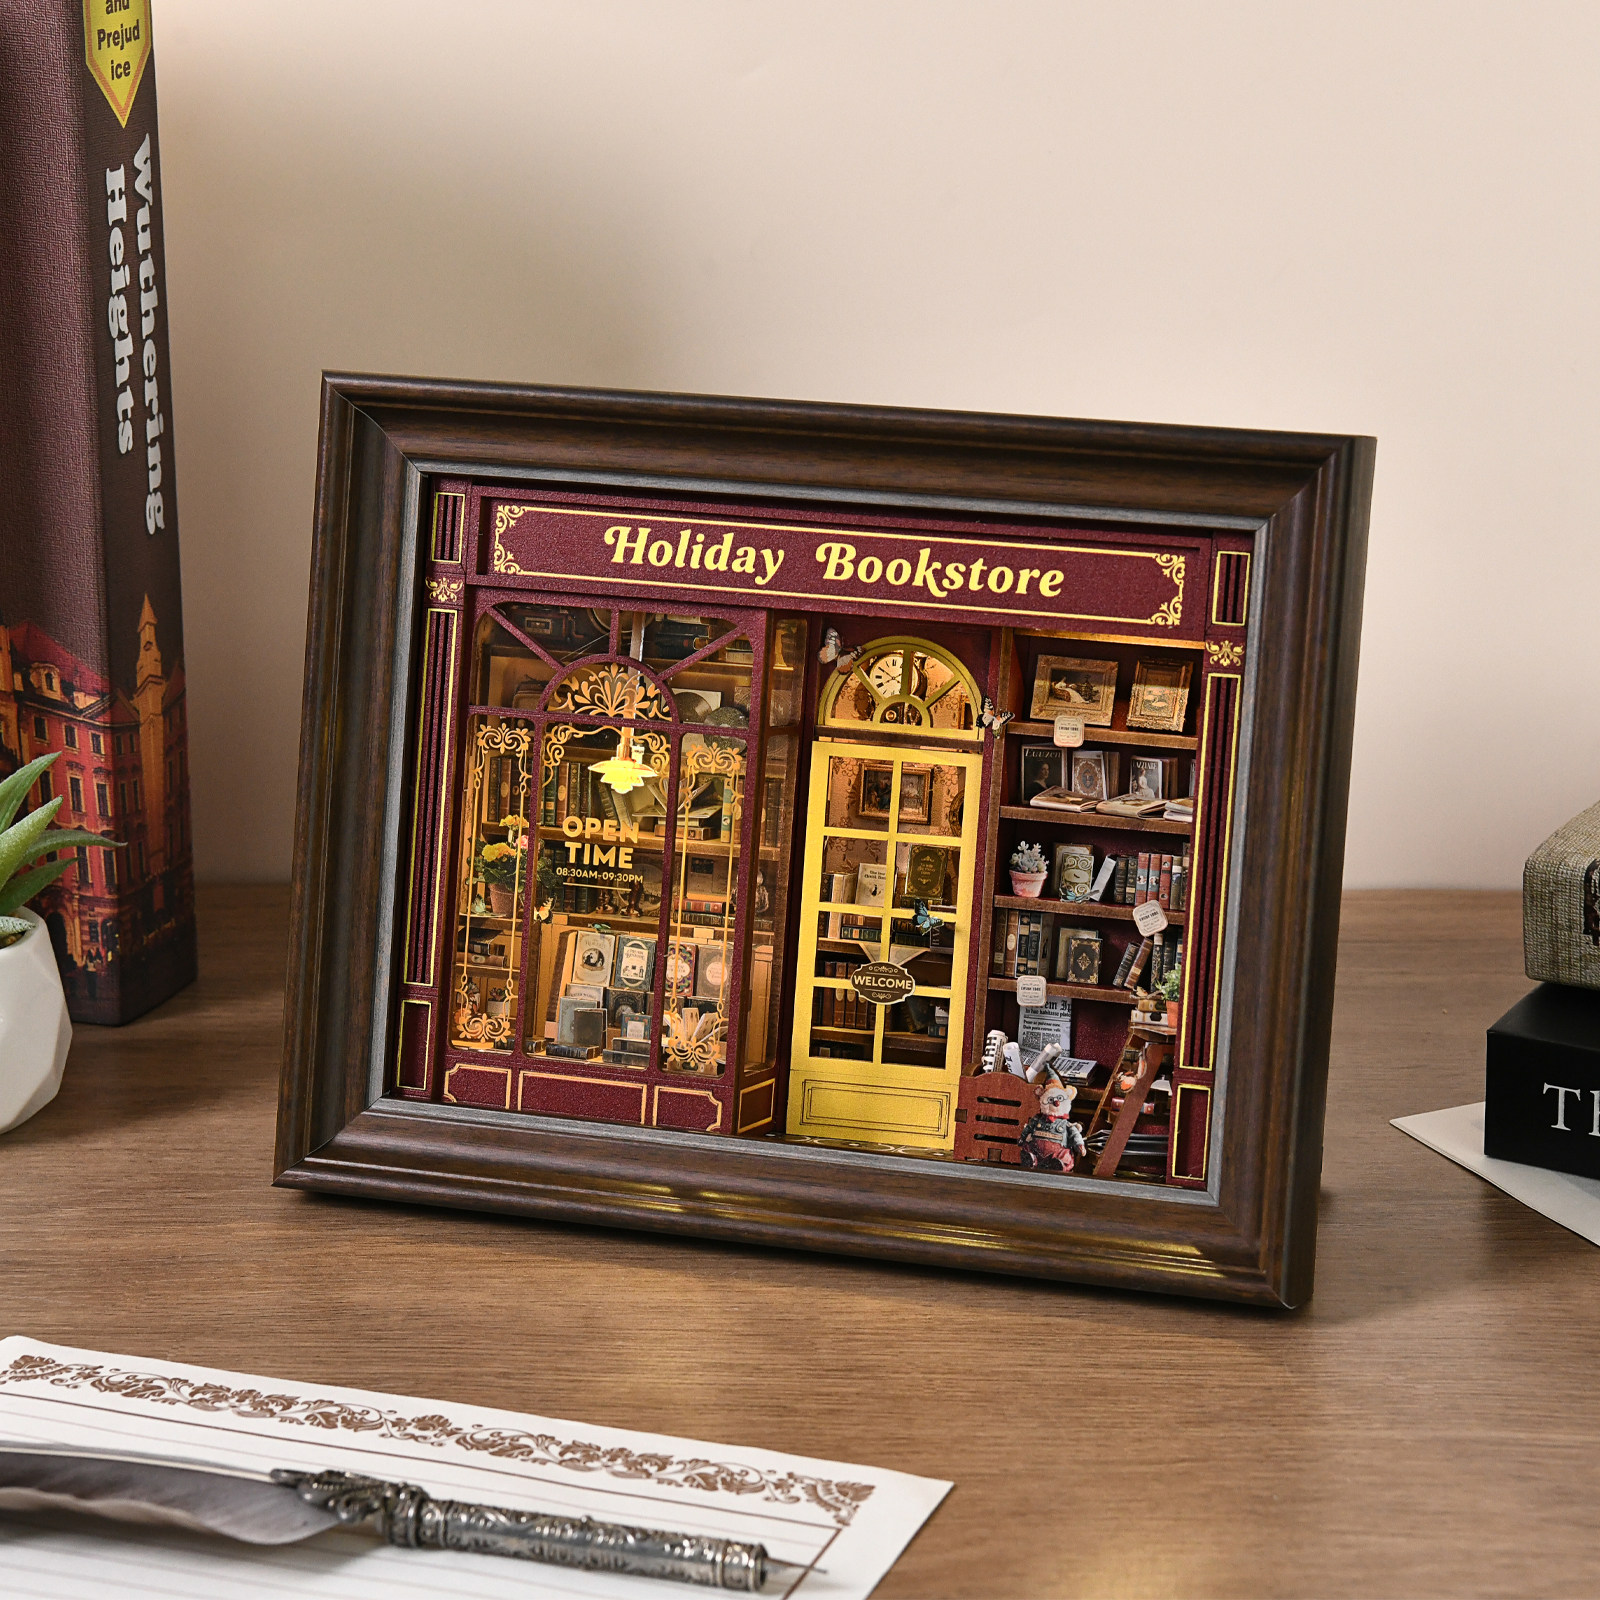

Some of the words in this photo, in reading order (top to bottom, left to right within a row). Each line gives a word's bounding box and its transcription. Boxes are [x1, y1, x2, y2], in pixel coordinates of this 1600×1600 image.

[97, 18, 140, 50] Prejud
[110, 59, 131, 80] ice
[106, 164, 133, 455] Heights
[132, 132, 165, 536] Wuthering
[604, 525, 785, 585] Holiday
[815, 542, 1065, 598] Bookstore
[562, 815, 640, 844] OPEN
[564, 841, 634, 869] TIME
[556, 866, 644, 884] 08:30AM-09:30PM
[853, 974, 914, 991] WELCOME
